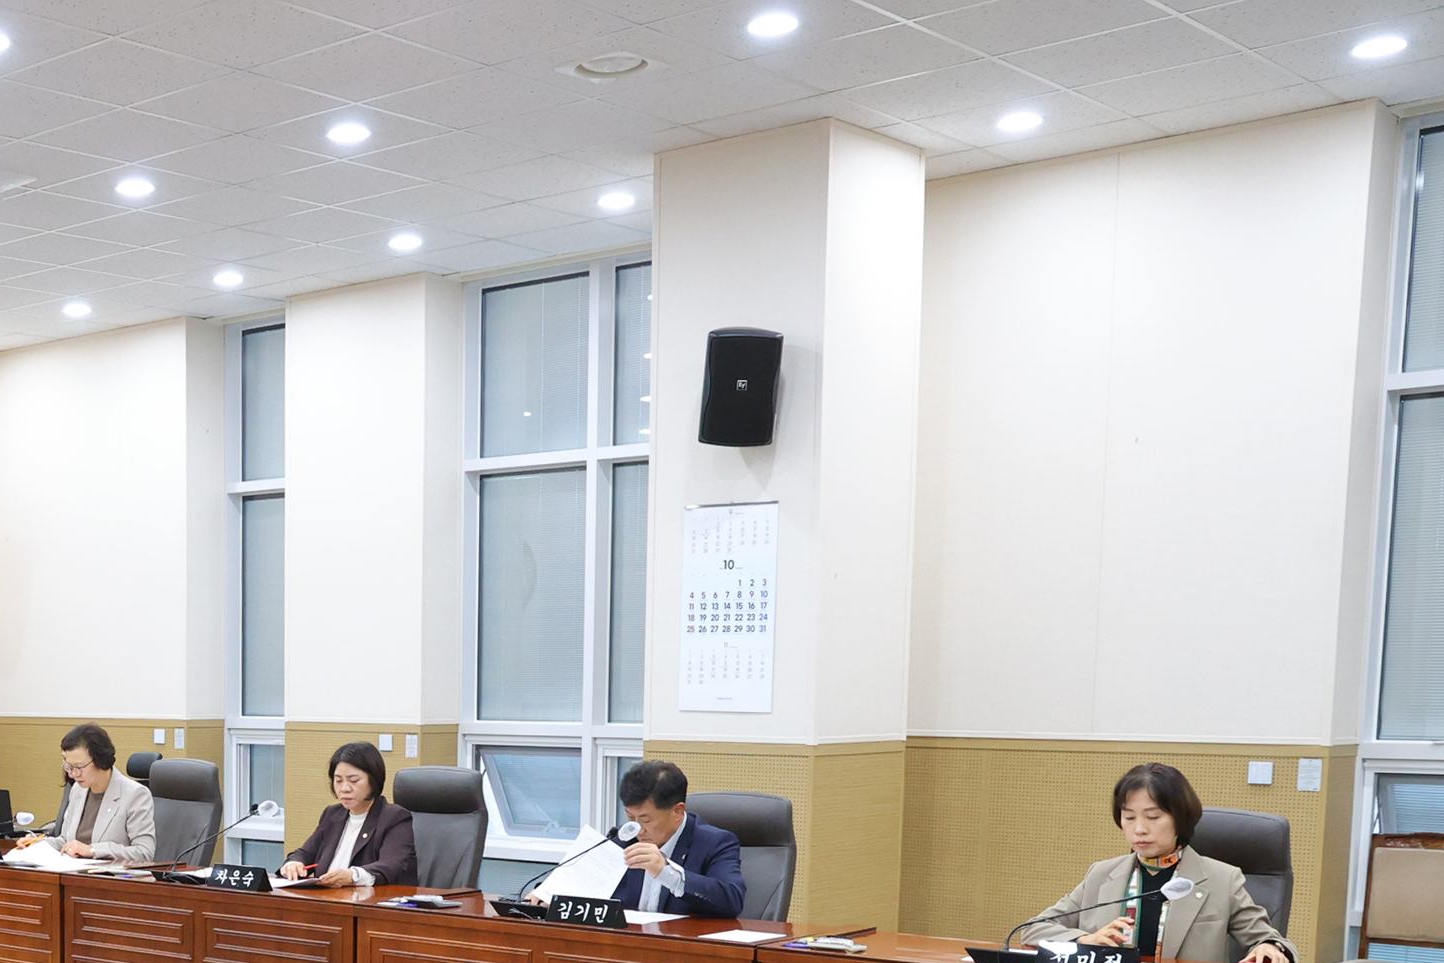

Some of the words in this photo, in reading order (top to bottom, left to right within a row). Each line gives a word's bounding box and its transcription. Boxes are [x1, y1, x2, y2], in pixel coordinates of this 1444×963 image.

[723, 559, 735, 570] 10
[750, 579, 755, 587] 2
[762, 578, 767, 586] 3
[701, 591, 706, 599] 5
[713, 591, 718, 599] 6
[737, 590, 742, 598] 8
[749, 590, 755, 598] 9
[760, 590, 768, 598] 10
[712, 602, 719, 610] 13
[723, 602, 731, 610] 14
[736, 602, 743, 610] 15
[688, 614, 695, 622] 18
[734, 613, 743, 621] 22
[747, 613, 756, 621] 23
[759, 613, 768, 621] 24
[686, 625, 695, 633] 25
[698, 625, 707, 633] 26
[710, 625, 719, 633] 27
[722, 625, 731, 633] 28
[734, 625, 743, 633] 29
[746, 625, 755, 633] 30
[215, 868, 254, 887] 차은숙
[557, 901, 609, 923] 김기민
